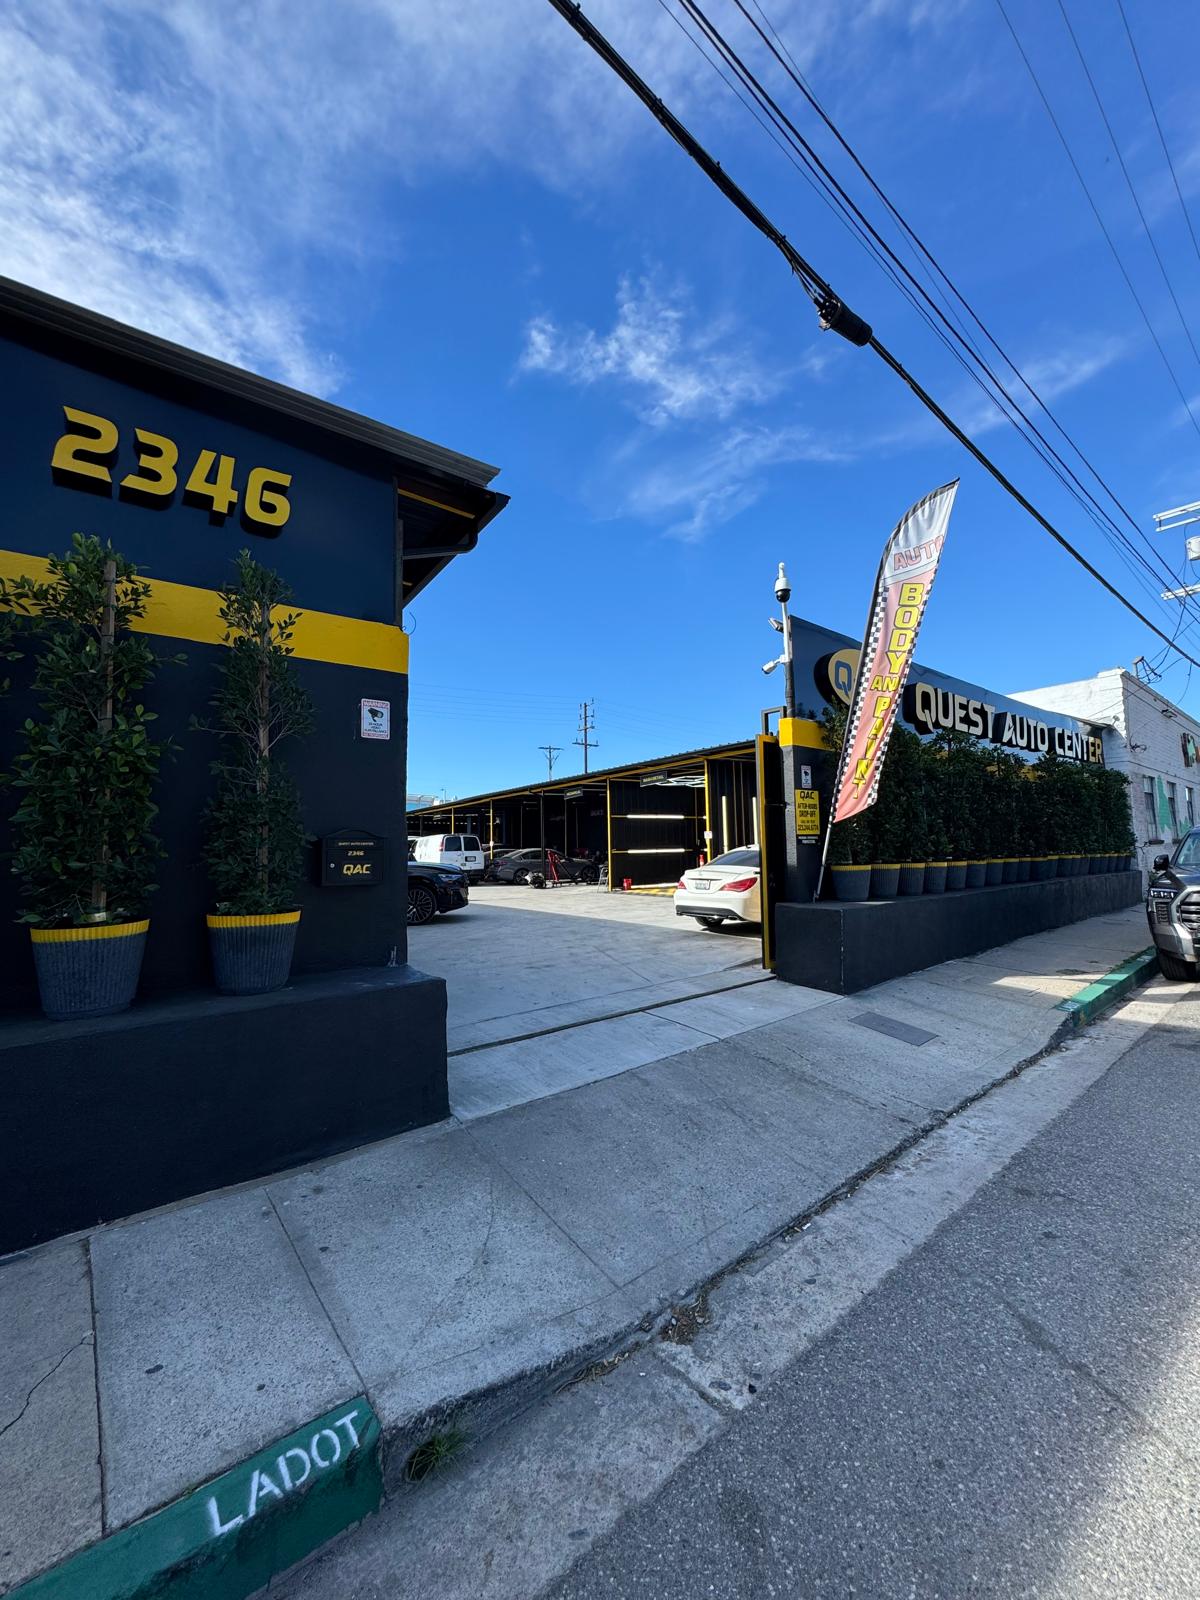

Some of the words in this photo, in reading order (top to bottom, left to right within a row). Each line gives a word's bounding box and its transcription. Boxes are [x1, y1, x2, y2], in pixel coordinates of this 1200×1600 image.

[51, 405, 292, 527] 2346
[886, 582, 925, 675] BODY
[915, 682, 996, 740] QUEST
[1002, 711, 1049, 753] AUTO
[1055, 726, 1104, 764] CENTER
[342, 863, 372, 876] QAC
[207, 1409, 361, 1536] LADOT
